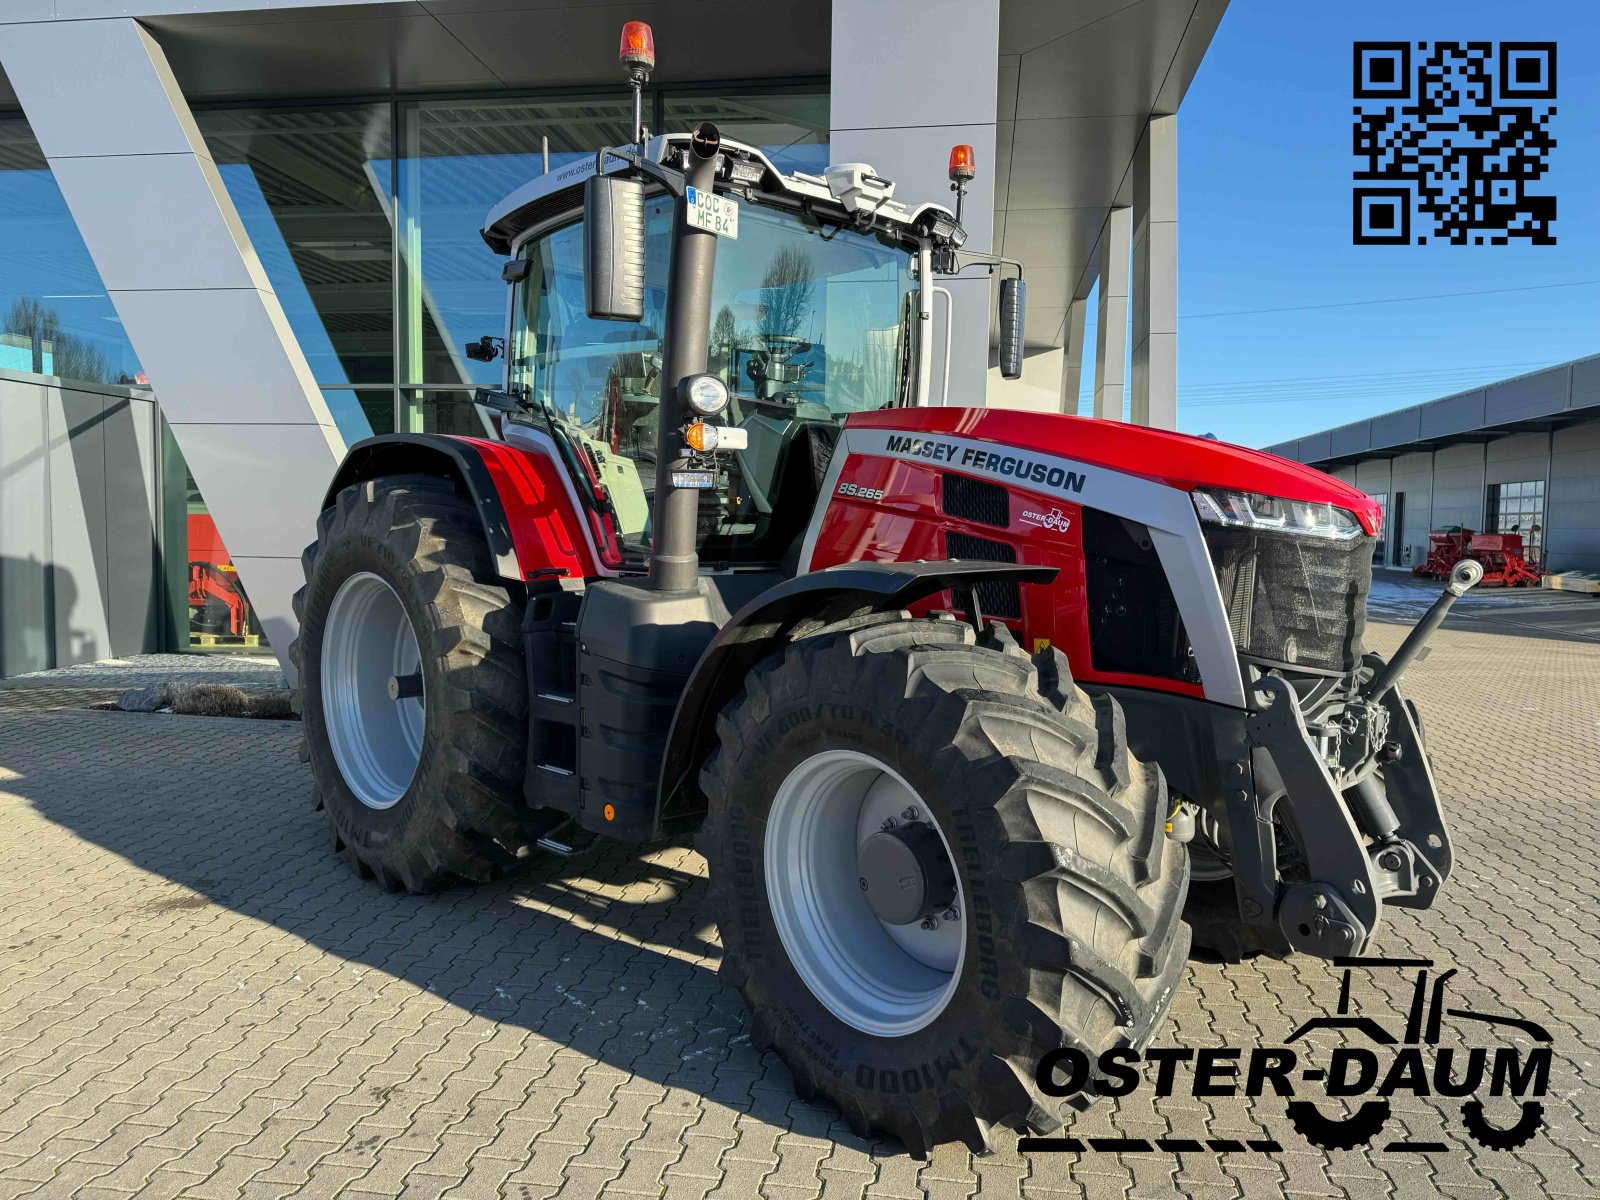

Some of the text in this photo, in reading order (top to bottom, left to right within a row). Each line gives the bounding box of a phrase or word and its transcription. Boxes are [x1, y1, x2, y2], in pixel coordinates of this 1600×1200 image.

[697, 191, 720, 214] COC
[697, 208, 729, 234] MF 84
[885, 435, 1086, 494] MASSEY FERGUSON
[837, 482, 884, 500] 8S.265
[1022, 510, 1070, 528] OSTER-DAUM
[951, 802, 1002, 1001] TRELLEBORG
